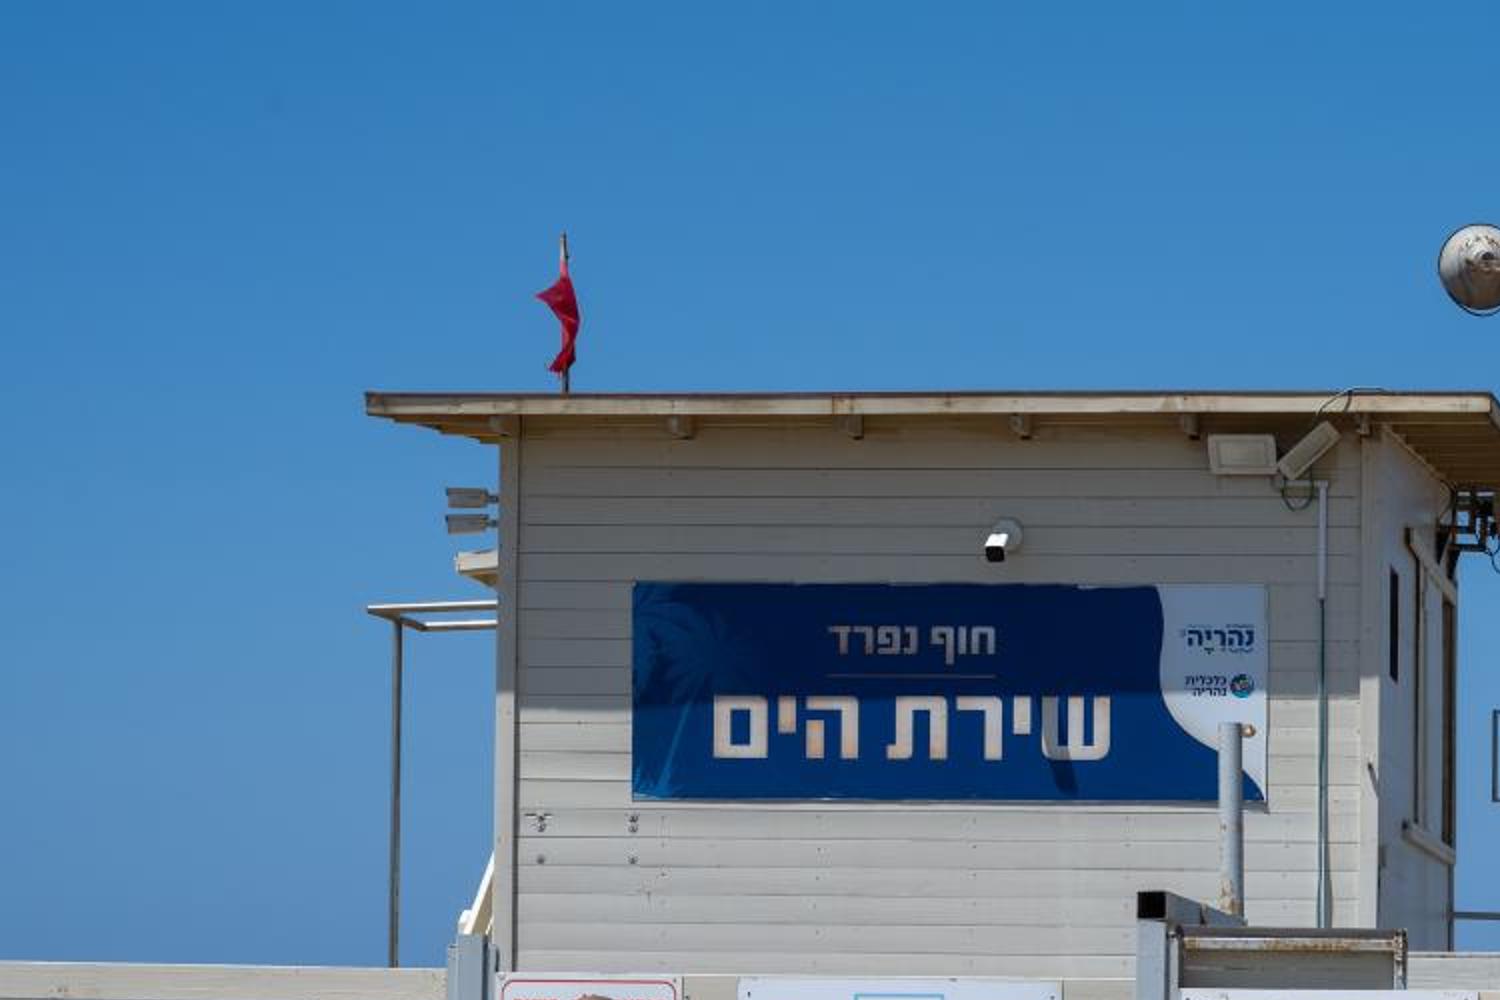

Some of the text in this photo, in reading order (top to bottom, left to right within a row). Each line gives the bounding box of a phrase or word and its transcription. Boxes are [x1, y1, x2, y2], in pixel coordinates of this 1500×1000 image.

[828, 626, 996, 664] חוף נפרד
[713, 696, 1111, 761] שירת הים
